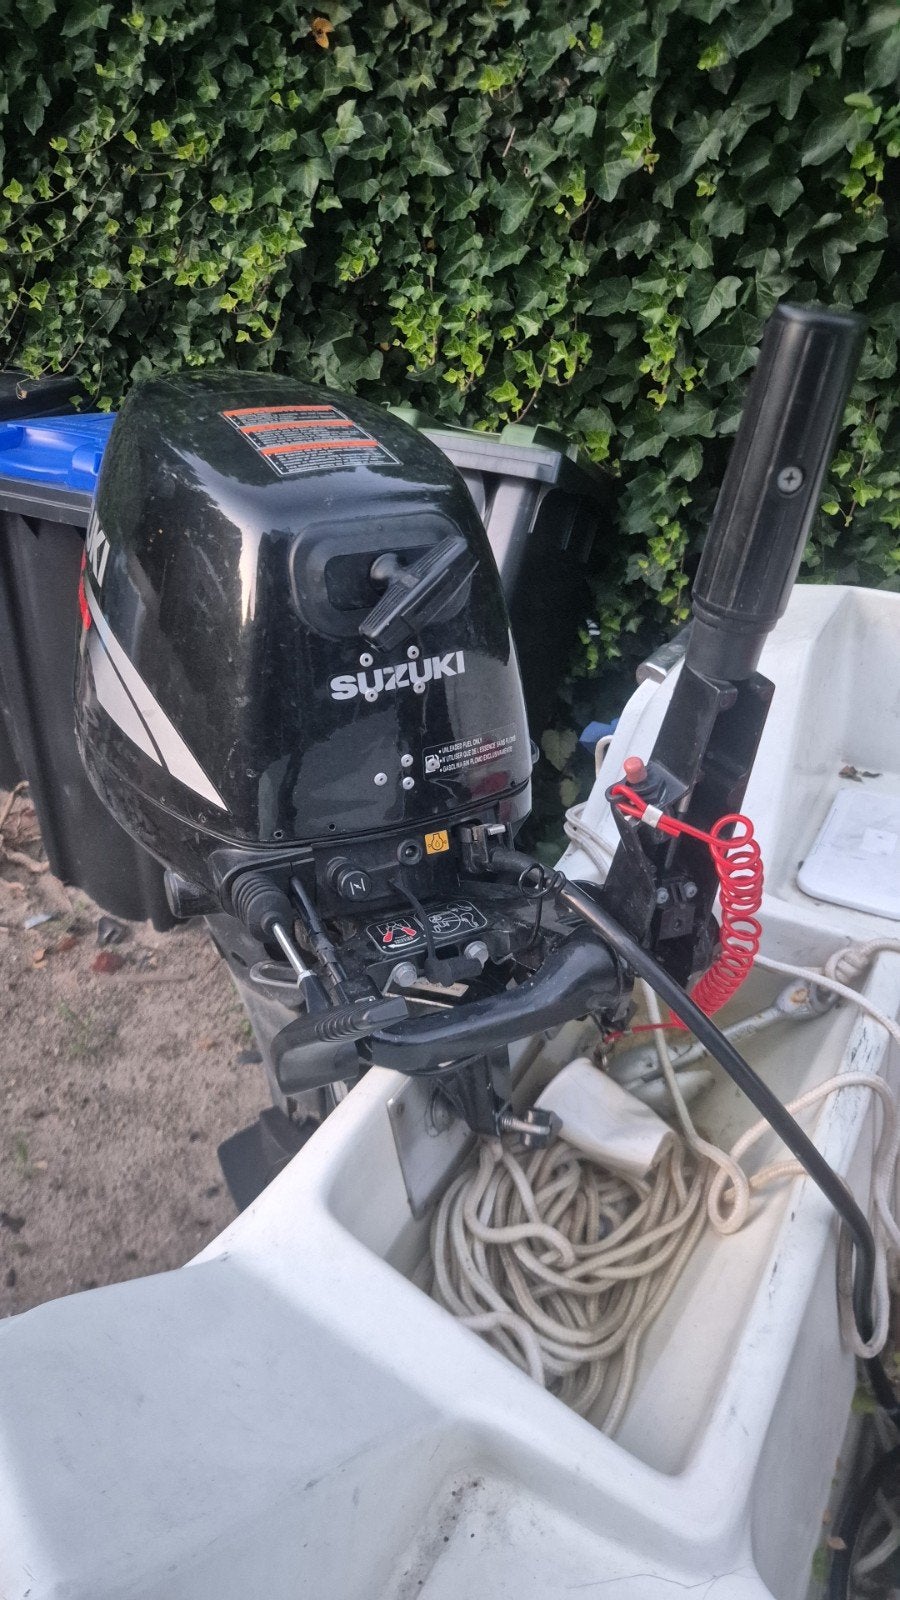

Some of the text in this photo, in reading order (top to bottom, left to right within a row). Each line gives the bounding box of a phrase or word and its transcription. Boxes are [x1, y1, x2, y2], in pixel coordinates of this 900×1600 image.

[330, 650, 465, 700] SUZUKI
[462, 740, 472, 748] FUEL
[472, 738, 482, 746] ONLY
